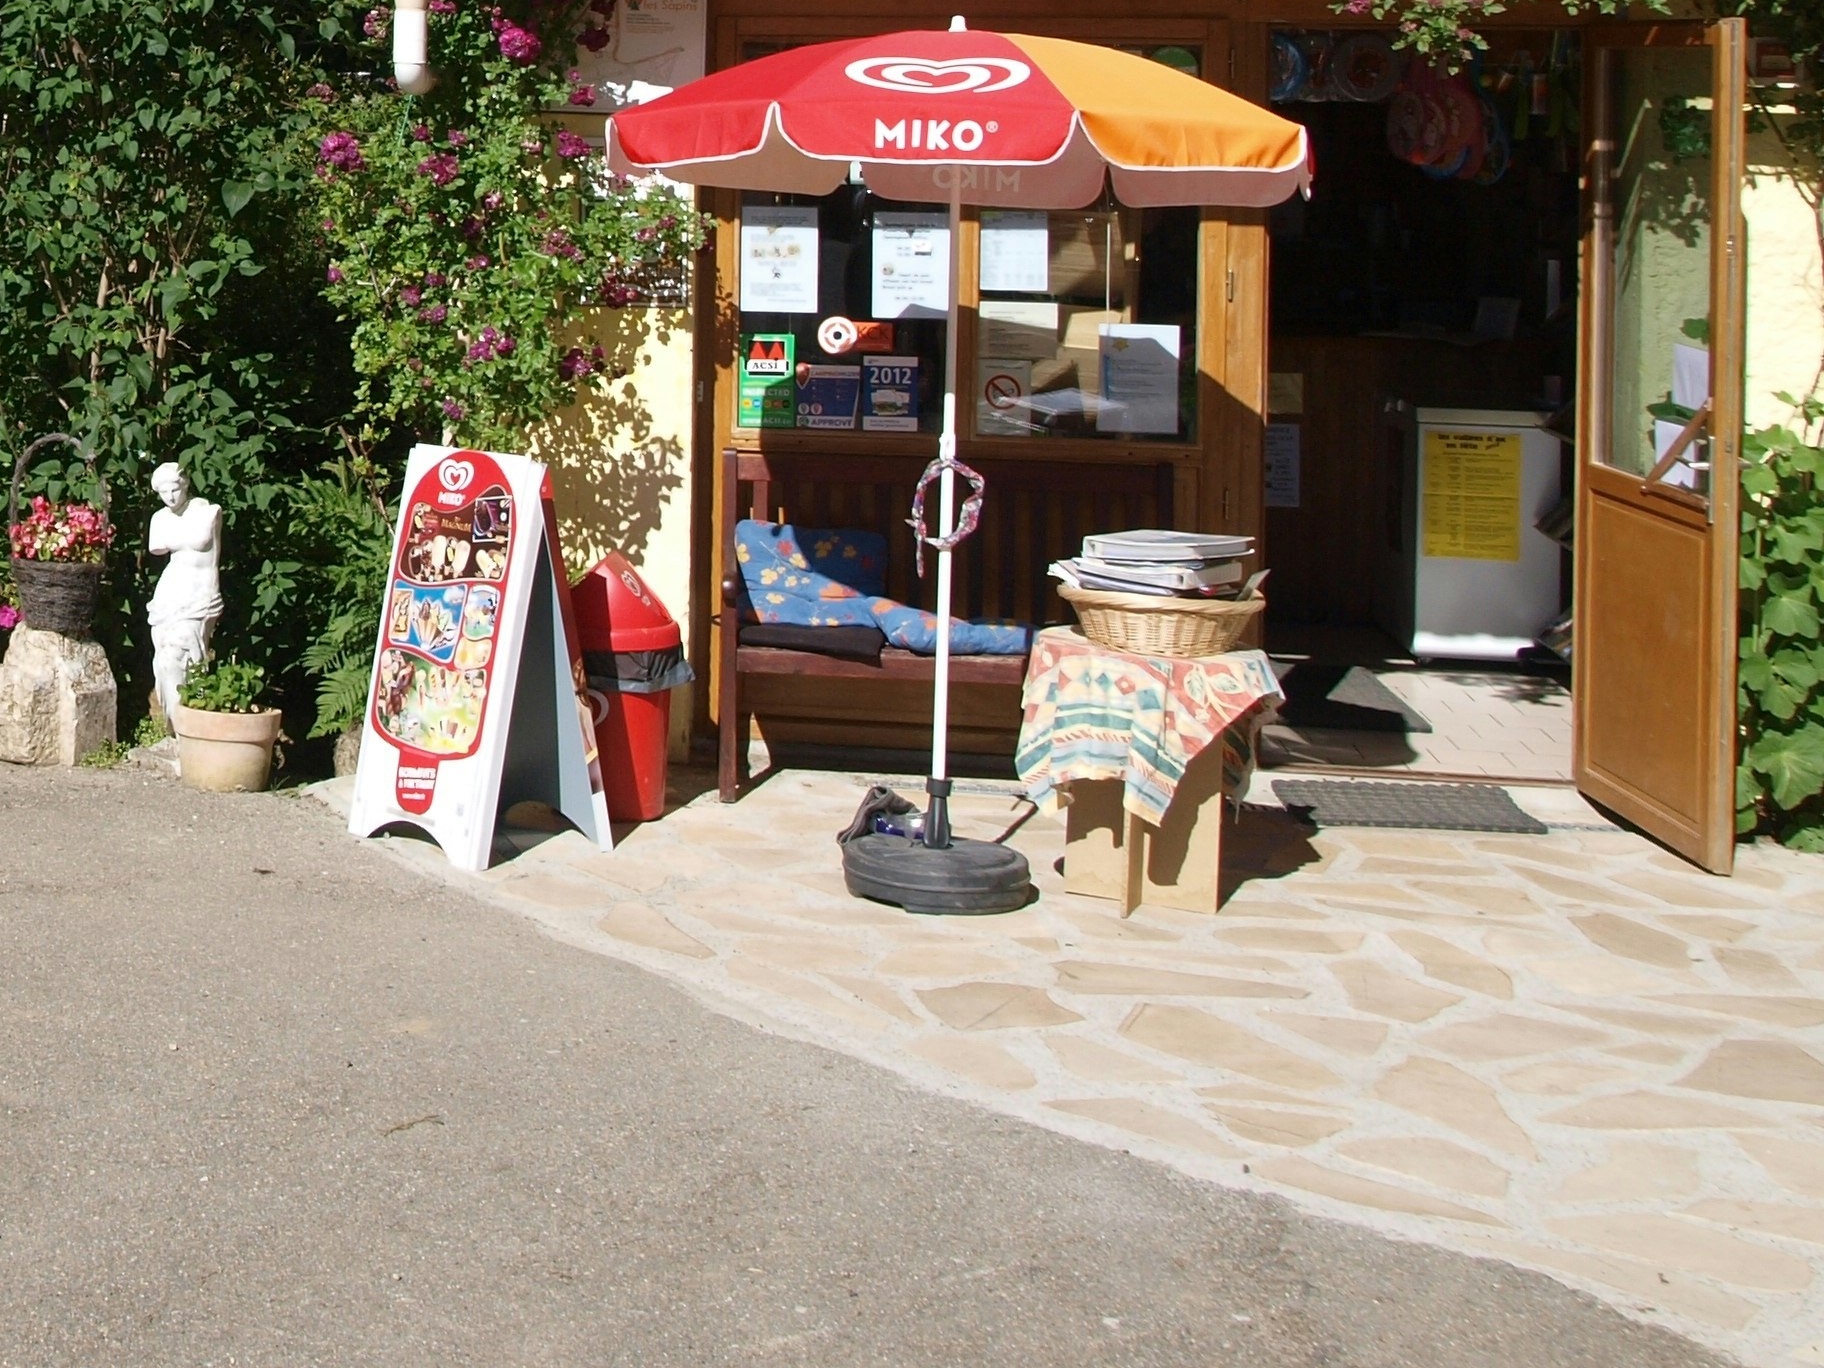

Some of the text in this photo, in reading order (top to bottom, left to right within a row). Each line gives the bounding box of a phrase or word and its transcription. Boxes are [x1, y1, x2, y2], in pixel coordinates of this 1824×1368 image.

[643, 0, 698, 11] les Sapins
[874, 118, 984, 152] MIKO
[752, 362, 778, 370] ACSI
[869, 367, 912, 385] 2012
